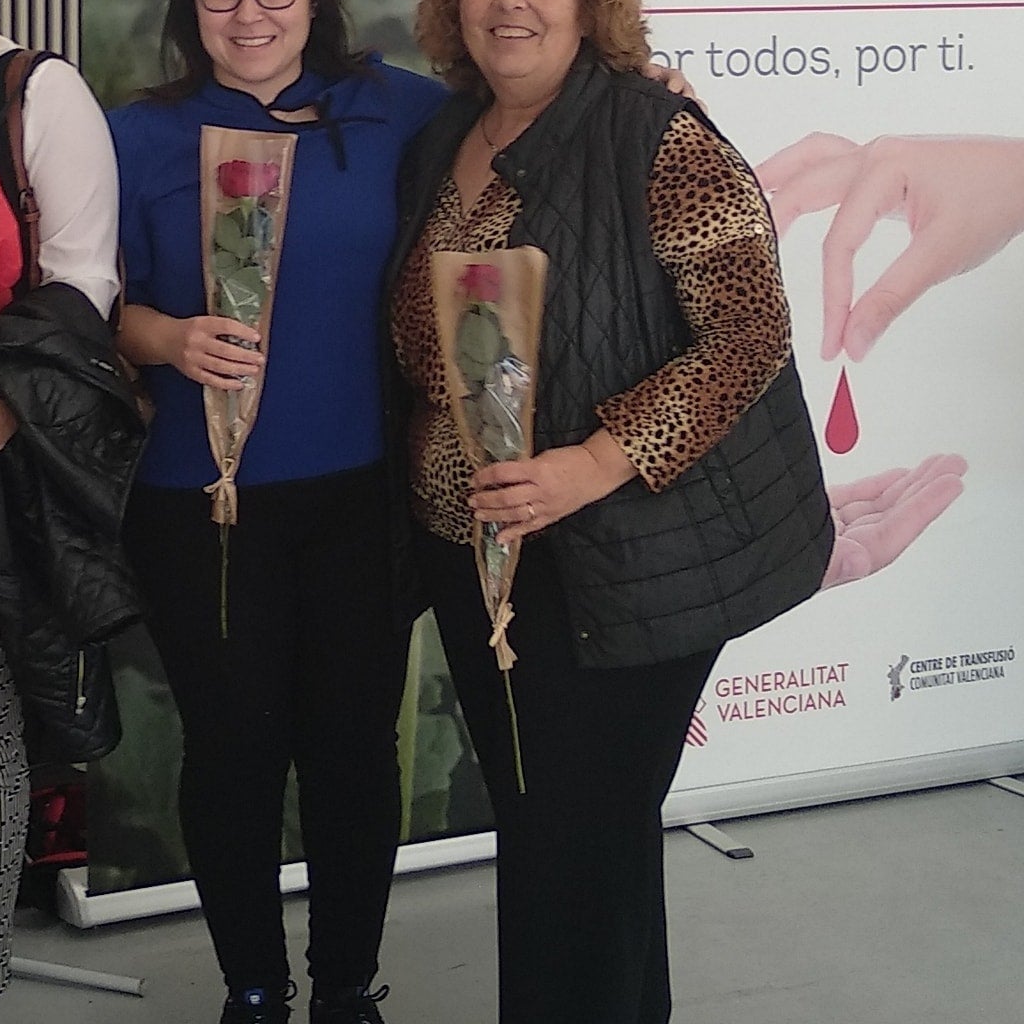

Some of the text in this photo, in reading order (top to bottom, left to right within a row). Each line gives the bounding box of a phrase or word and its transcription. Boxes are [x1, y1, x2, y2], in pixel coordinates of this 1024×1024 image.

[650, 33, 975, 86] or todos, por ti.
[715, 663, 849, 697] GENERALITAT
[910, 658, 943, 673] CENTRE
[945, 656, 957, 669] DE
[717, 689, 846, 722] VALENCIANA
